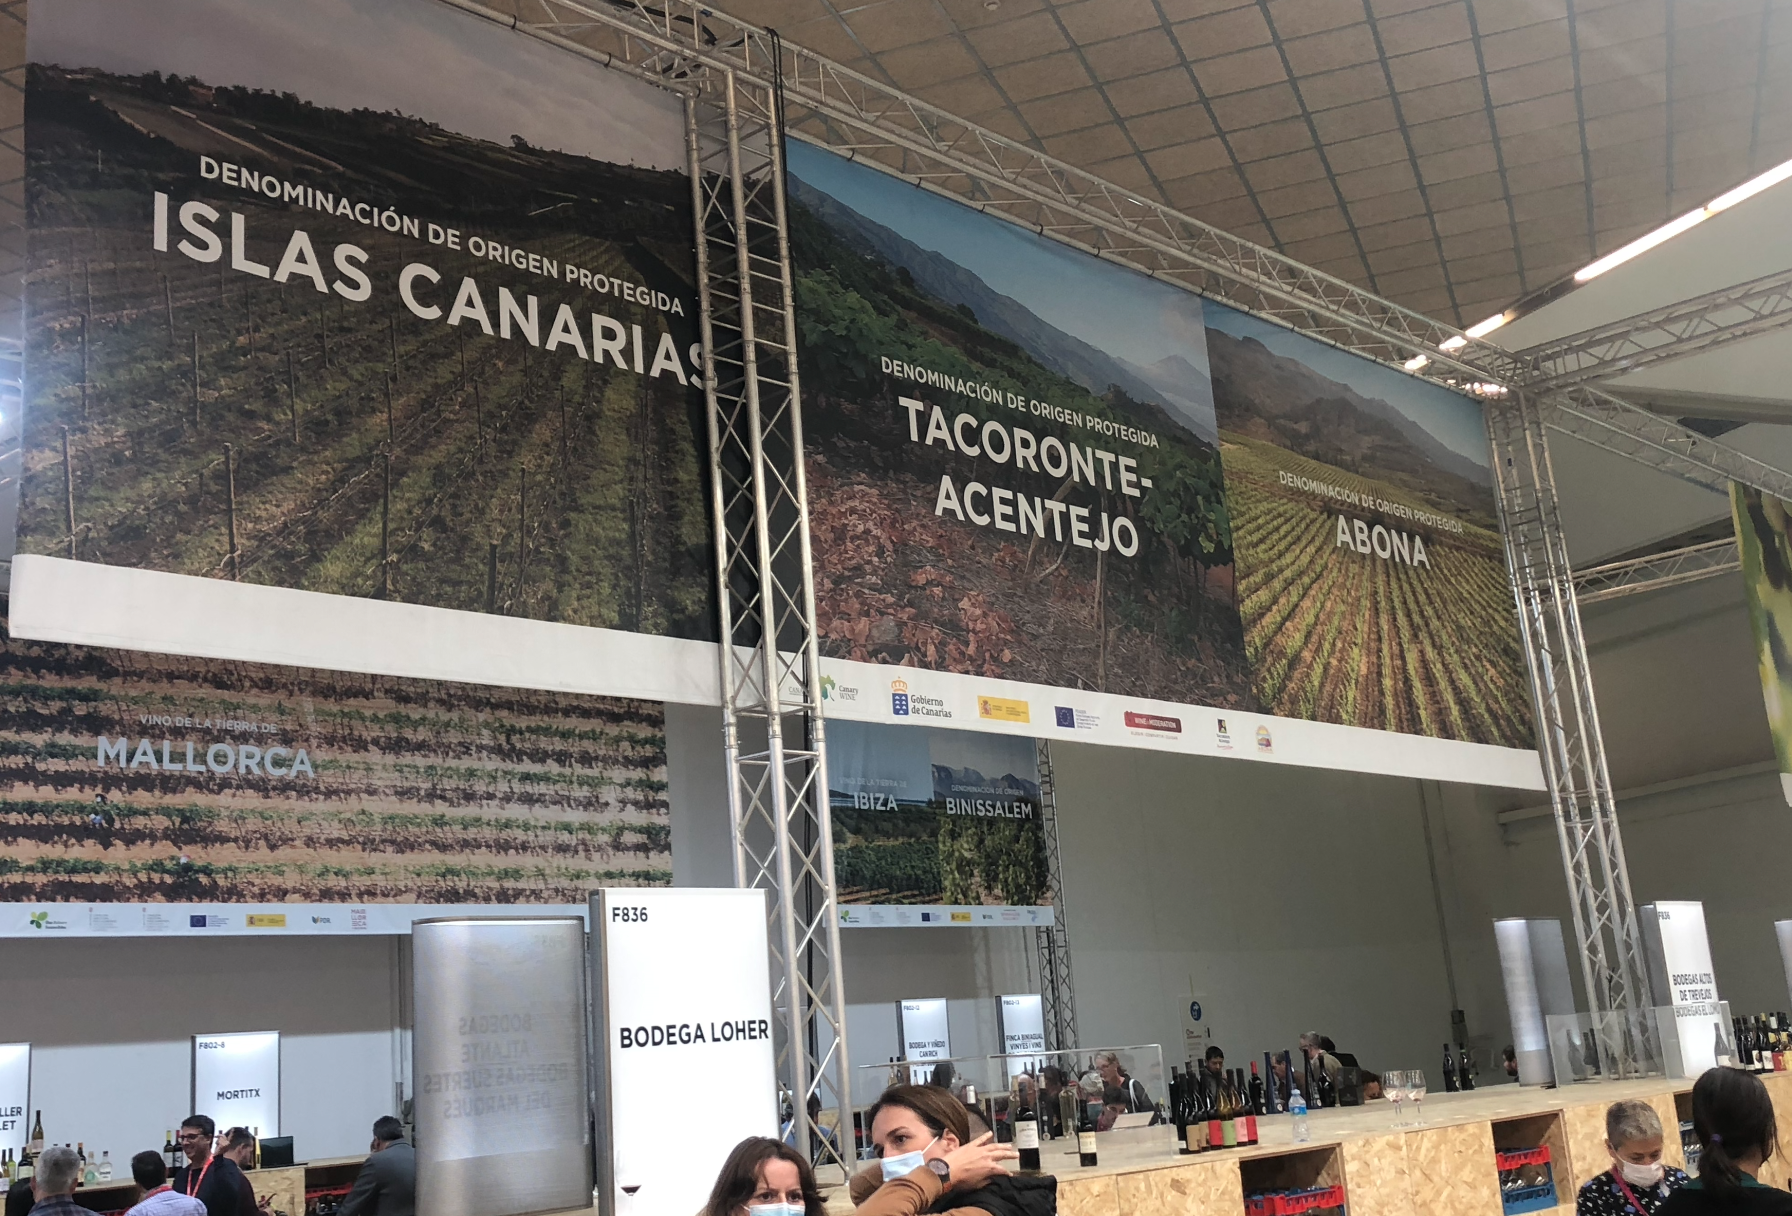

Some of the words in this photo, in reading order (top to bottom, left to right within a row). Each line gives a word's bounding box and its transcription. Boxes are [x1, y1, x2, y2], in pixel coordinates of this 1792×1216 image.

[200, 155, 420, 239] DENOMINACIÓN
[428, 222, 462, 252] DE
[468, 236, 559, 280] ORIGEN
[565, 264, 685, 317] PROTEGIDA
[153, 191, 373, 302] ISLAS
[399, 262, 718, 391] CANARIAS
[881, 355, 1003, 406] DENOMINACIÓN
[1007, 392, 1026, 412] DE
[1030, 400, 1082, 428] ORIGEN
[1086, 414, 1160, 449] PROTEGIDA
[898, 395, 1153, 498] TACORONTE-
[1279, 470, 1360, 505] DENOMINACIÓN
[1361, 496, 1375, 510] DE
[1376, 498, 1413, 520] ORIGEN
[1414, 511, 1465, 535] PROTEGIDA
[935, 474, 1139, 557] ACENTEJO
[1336, 514, 1431, 570] ABONA
[839, 685, 859, 695] Canary
[840, 693, 856, 701] WINE
[910, 694, 944, 708] Gobierno
[911, 706, 921, 716] de
[921, 707, 952, 719] Canarias
[140, 714, 172, 727] VINO
[175, 716, 193, 728] DE
[196, 717, 212, 729] LA
[215, 718, 258, 732] TIERRA
[261, 722, 278, 733] DE
[97, 735, 315, 778] MALLORCA
[853, 791, 899, 812] IBIZA
[946, 797, 1033, 819] BINISSALEM
[611, 906, 649, 923] F836
[1672, 973, 1699, 985] BODEGAS
[1679, 989, 1688, 1001] DE
[1688, 988, 1713, 1000] TREVEJOS
[619, 1022, 706, 1049] BODEGA
[710, 1019, 769, 1043] LOHER
[909, 1041, 926, 1049] BODEGA
[216, 1087, 261, 1101] MORTITX
